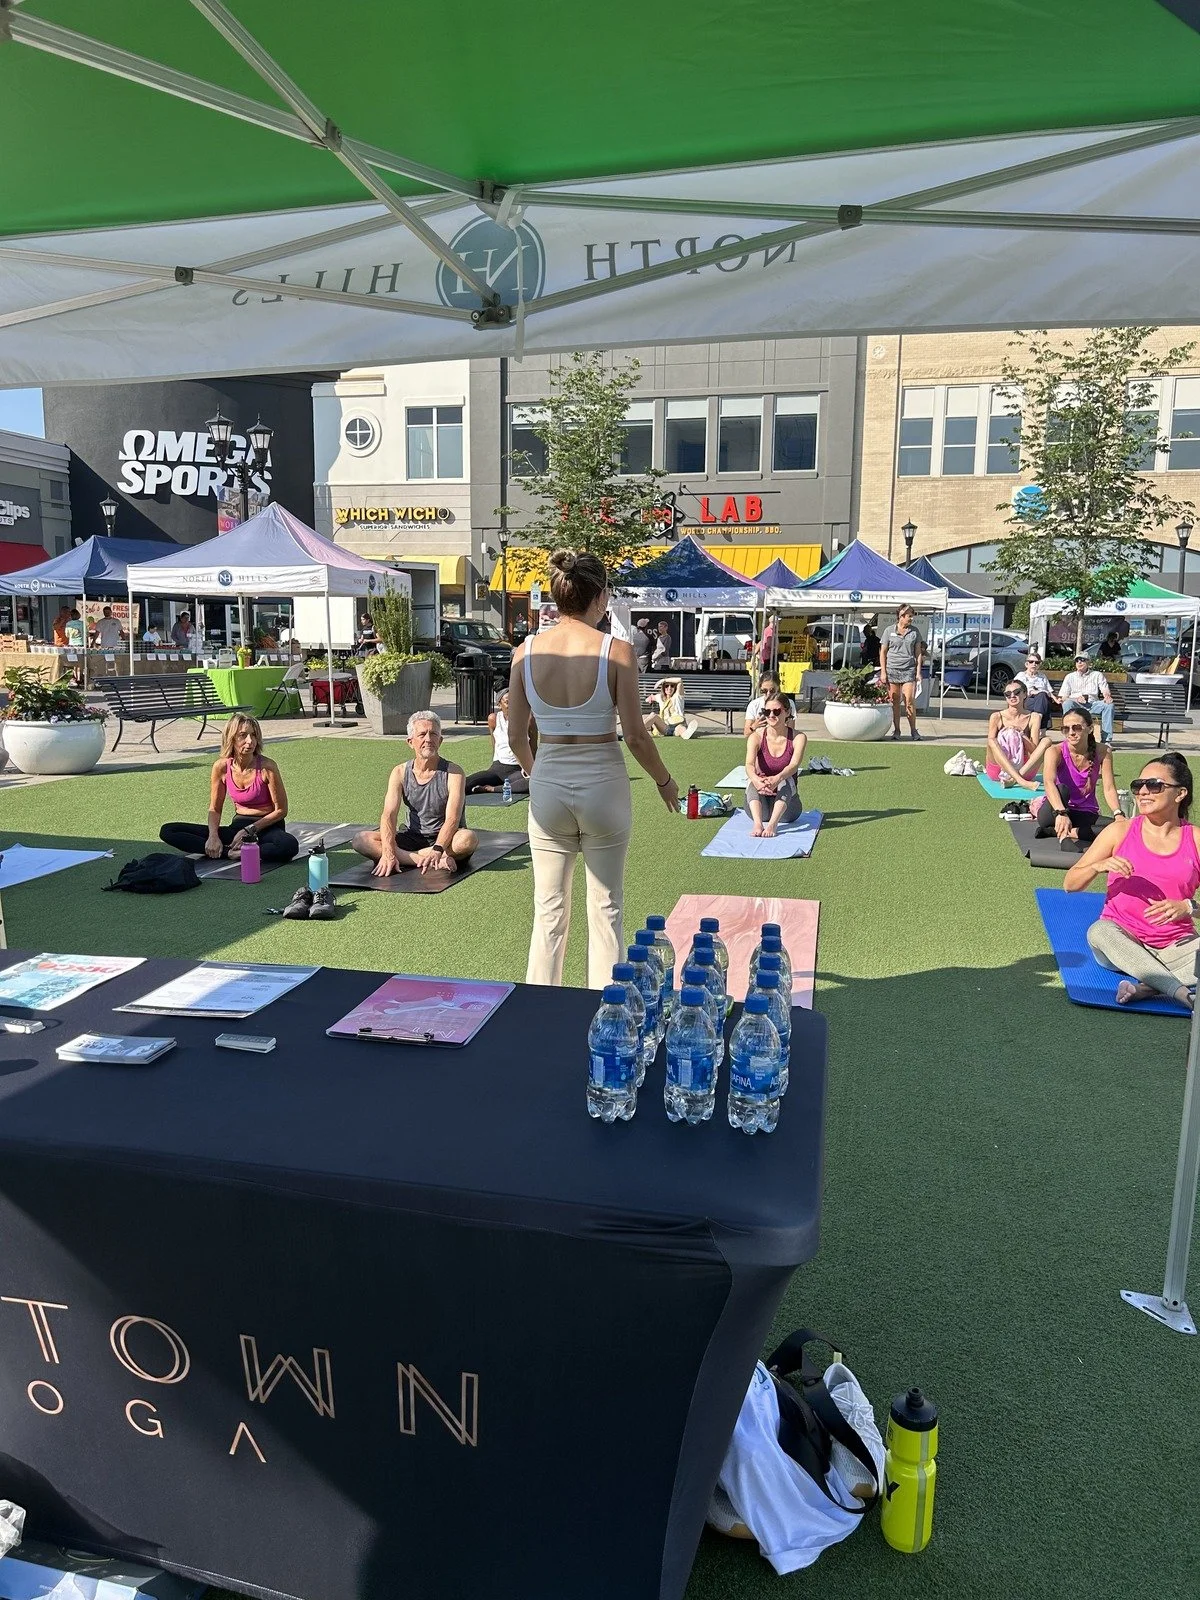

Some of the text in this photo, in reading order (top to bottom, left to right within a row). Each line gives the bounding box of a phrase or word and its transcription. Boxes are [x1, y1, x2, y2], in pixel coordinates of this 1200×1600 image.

[335, 506, 437, 524] WHICH WICH
[701, 495, 763, 523] LAB
[681, 526, 705, 535] WORLD
[182, 575, 212, 583] NORTH
[0, 1295, 479, 1448] TOWN
